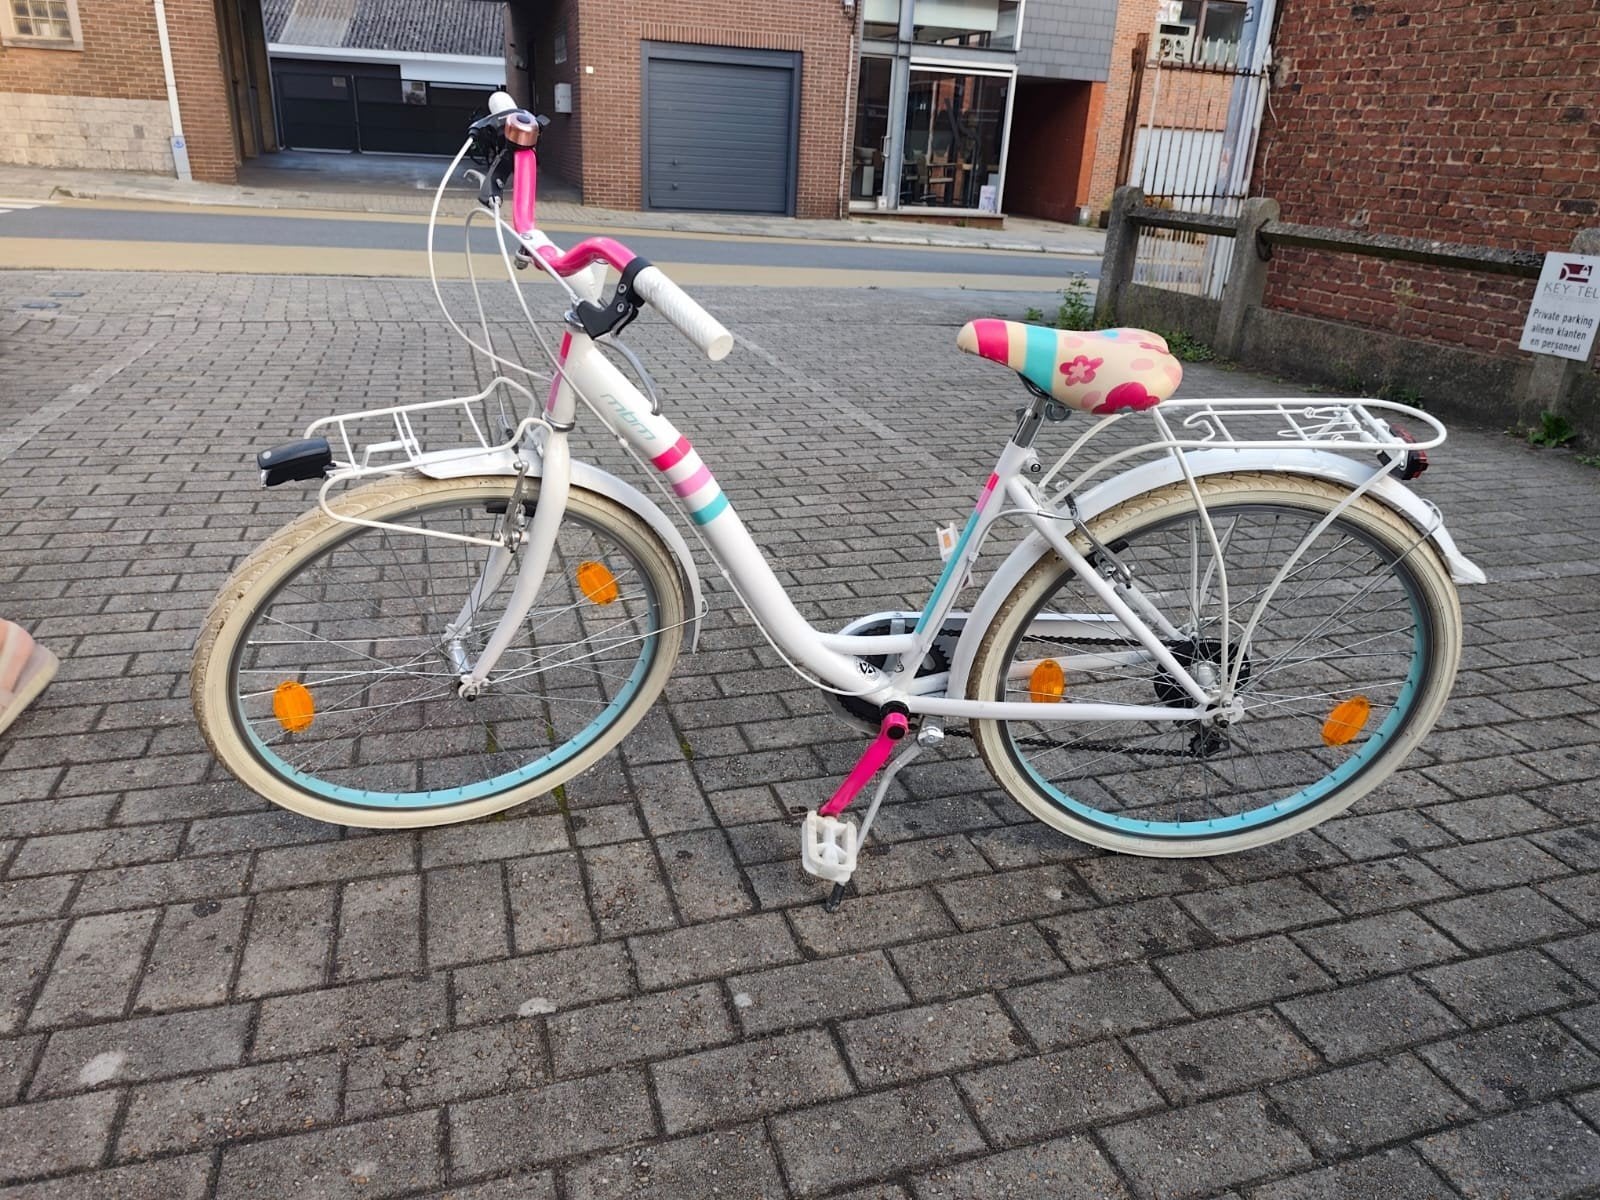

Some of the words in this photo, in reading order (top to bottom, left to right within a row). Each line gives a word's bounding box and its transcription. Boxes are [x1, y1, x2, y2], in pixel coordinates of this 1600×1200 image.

[1544, 282, 1571, 294] KEY
[1532, 308, 1560, 321] Private
[1562, 314, 1593, 328] parking
[1531, 324, 1554, 335] alleen
[1556, 327, 1587, 341] klanten
[1530, 338, 1540, 346] en
[1541, 340, 1580, 353] personeel
